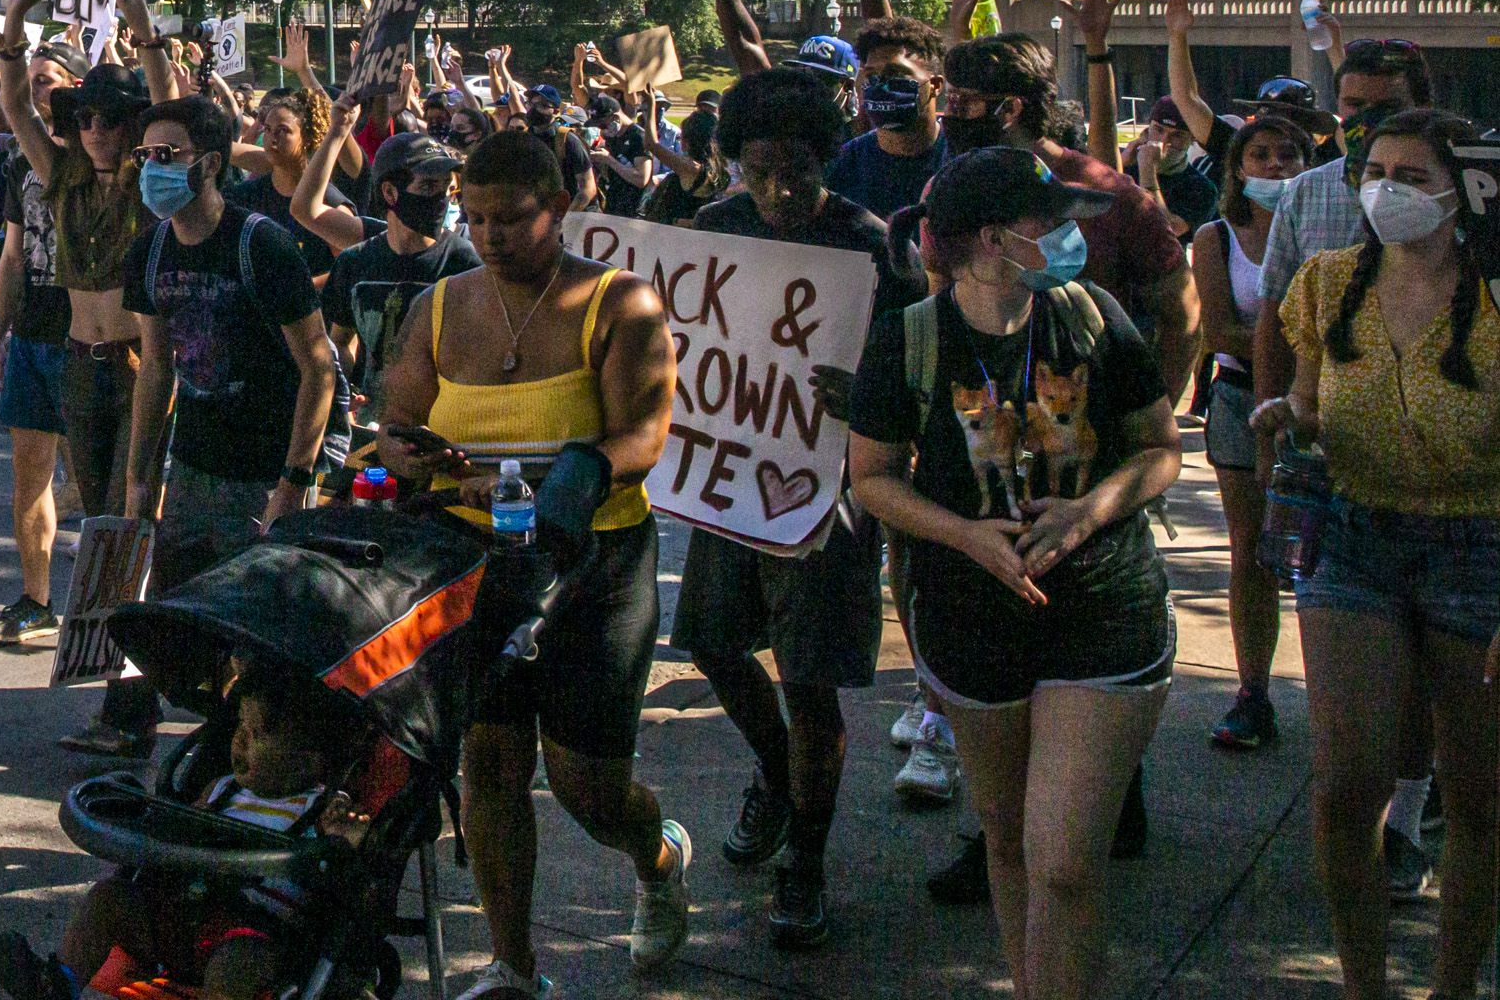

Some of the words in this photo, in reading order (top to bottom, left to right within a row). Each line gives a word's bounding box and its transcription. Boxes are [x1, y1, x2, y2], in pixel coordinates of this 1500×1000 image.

[771, 278, 825, 358] &
[668, 332, 826, 451] ROWN
[668, 422, 753, 513] TE
